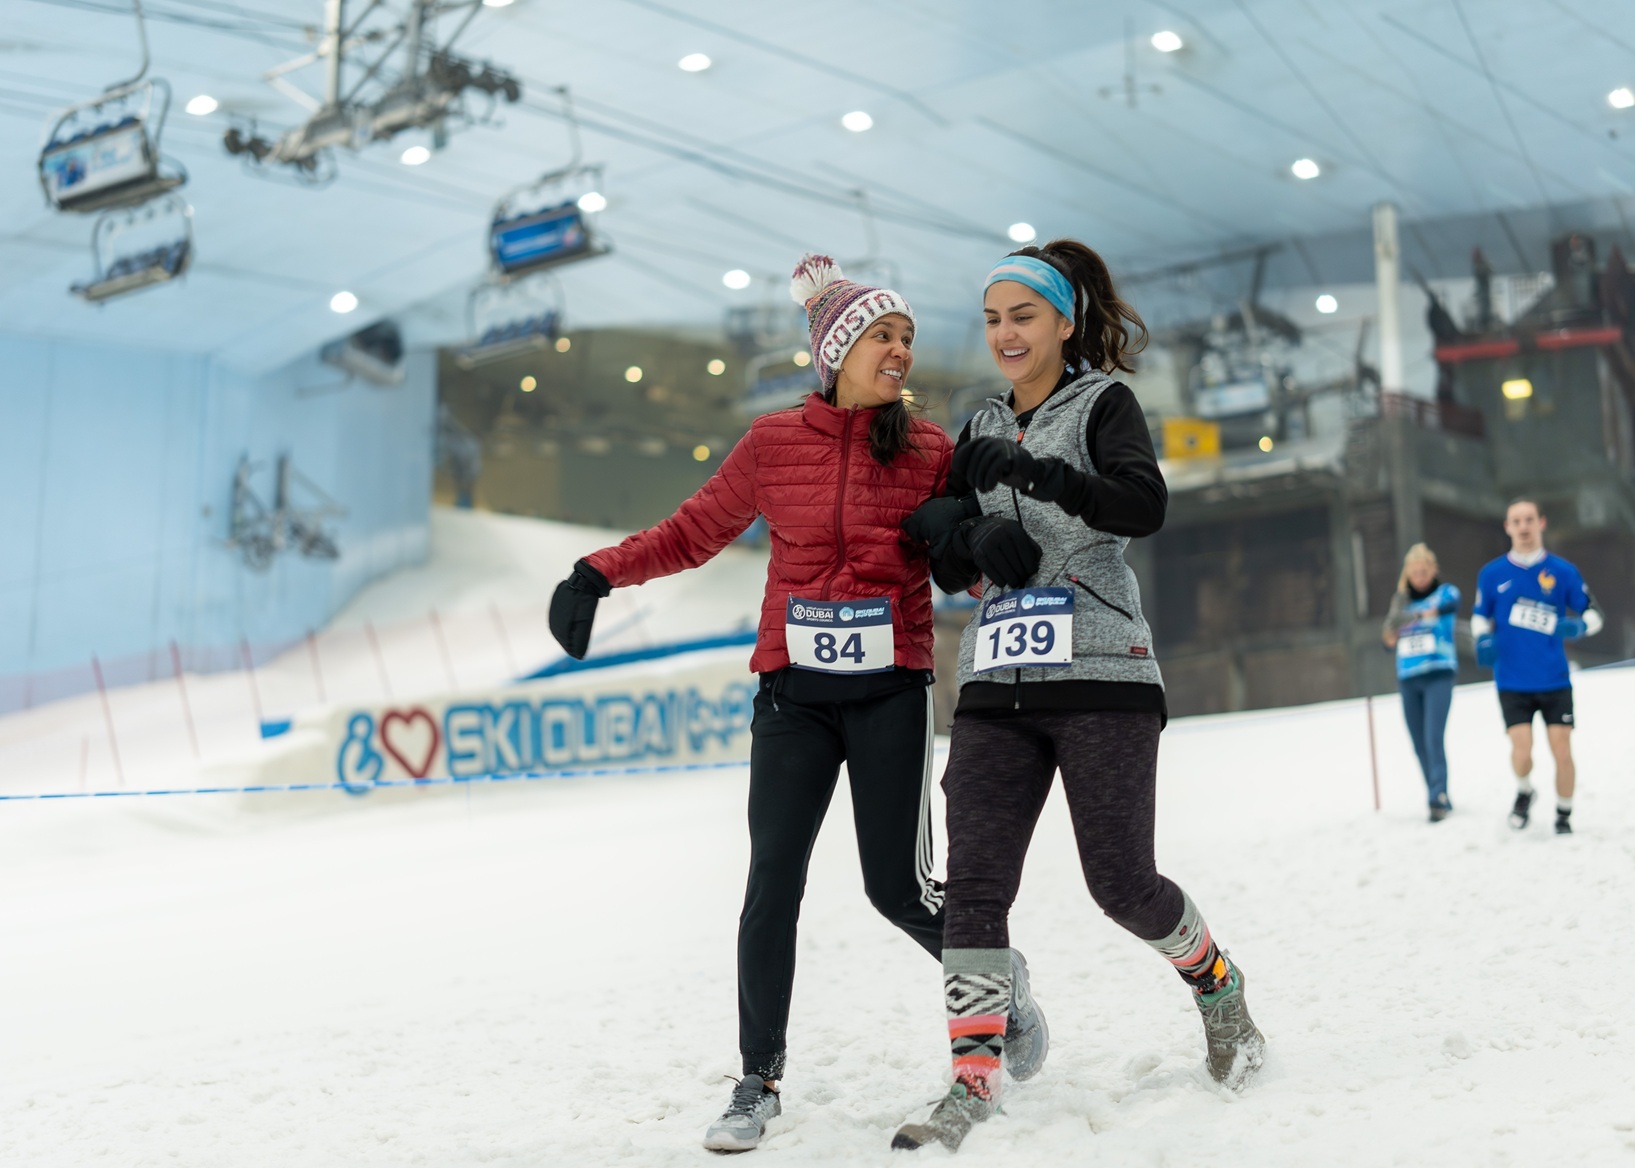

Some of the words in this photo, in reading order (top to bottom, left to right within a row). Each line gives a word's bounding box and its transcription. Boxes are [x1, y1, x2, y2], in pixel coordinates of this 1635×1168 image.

[823, 293, 896, 364] COSTA
[806, 610, 833, 619] DUBAI
[995, 600, 1017, 613] DUBAI
[814, 632, 866, 664] 84
[989, 620, 1055, 660] 139
[446, 698, 535, 777] SKI
